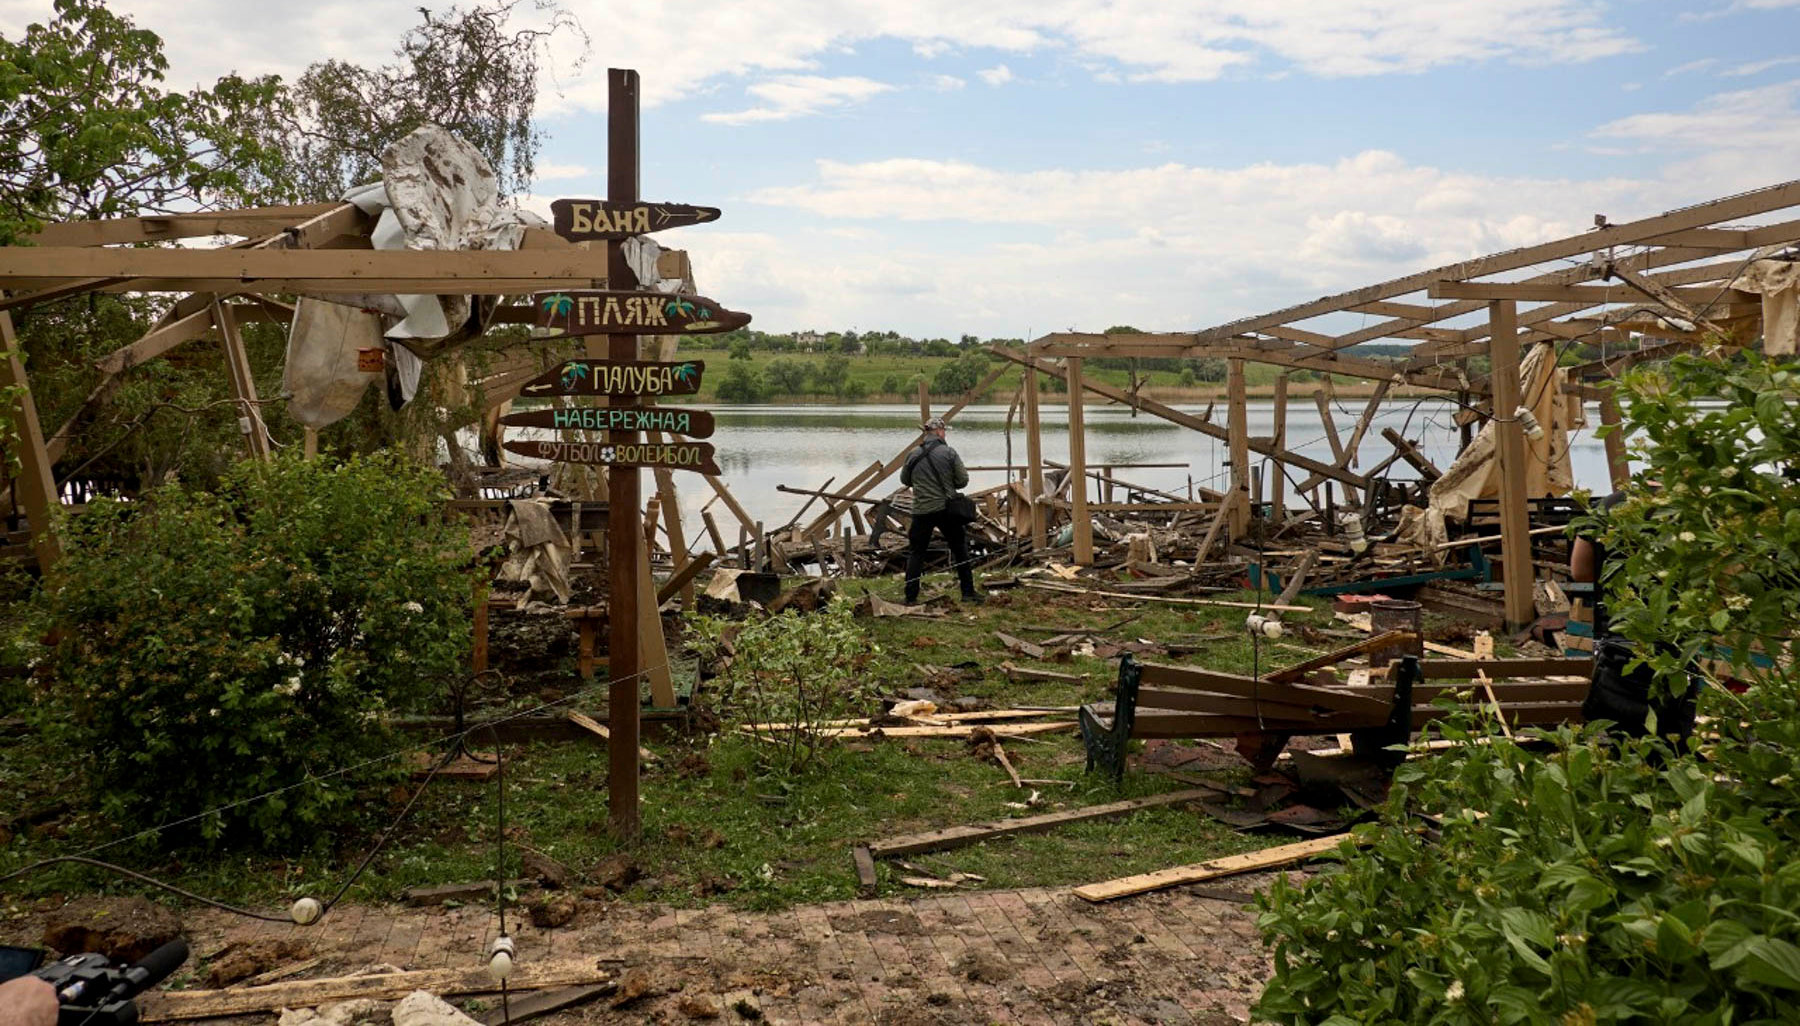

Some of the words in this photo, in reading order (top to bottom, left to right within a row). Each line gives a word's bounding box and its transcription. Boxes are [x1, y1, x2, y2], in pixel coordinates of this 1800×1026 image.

[577, 296, 668, 327] ПЛЯЖ
[593, 365, 673, 395] ПАЛУБА
[553, 408, 691, 433] НАБЕРЕЖНАЯ
[537, 441, 600, 464] ФУТБОЛ
[616, 444, 702, 466] ВОЛЕЙБОЛ
